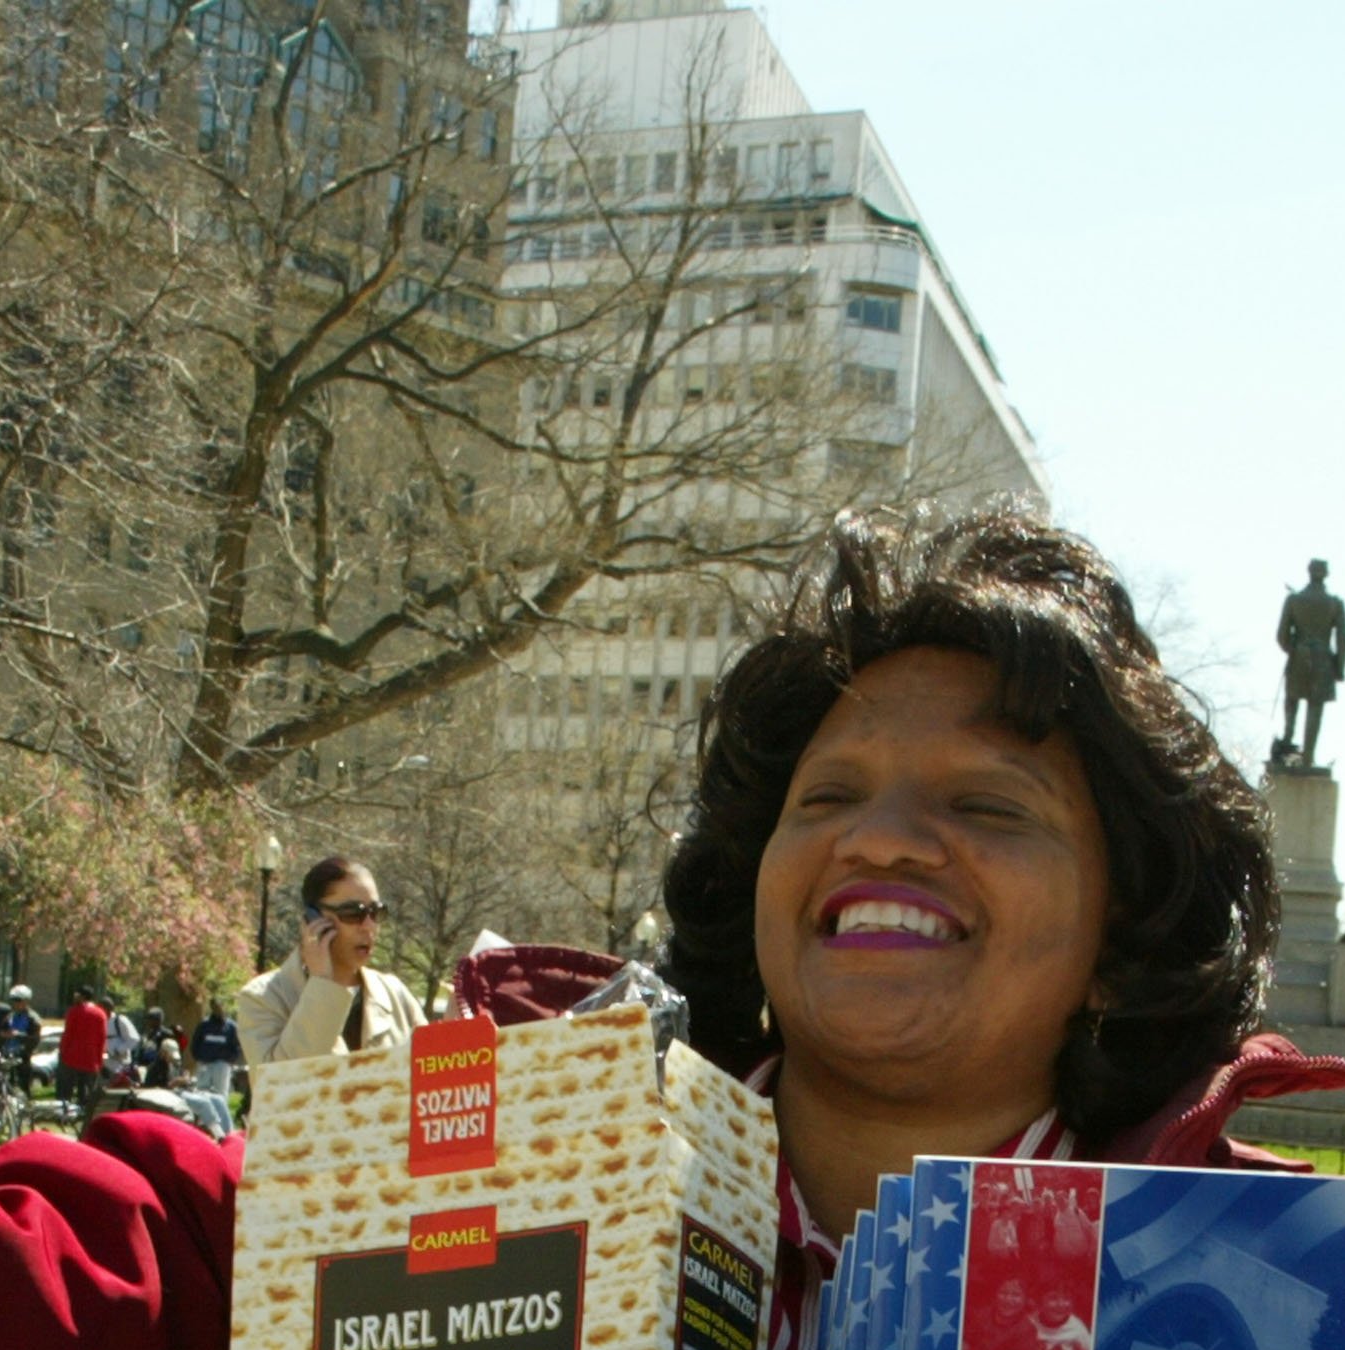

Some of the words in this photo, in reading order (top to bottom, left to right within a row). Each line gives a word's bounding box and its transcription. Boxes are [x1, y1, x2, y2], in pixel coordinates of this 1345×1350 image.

[415, 1047, 492, 1075] CARMEL
[416, 1082, 491, 1117] MATZOS
[420, 1112, 486, 1144] ISRAEL
[412, 1226, 491, 1251] CARMEL
[685, 1255, 720, 1296] ISRAEL
[689, 1231, 756, 1293] CARMEL
[447, 1291, 563, 1344] MATZOS
